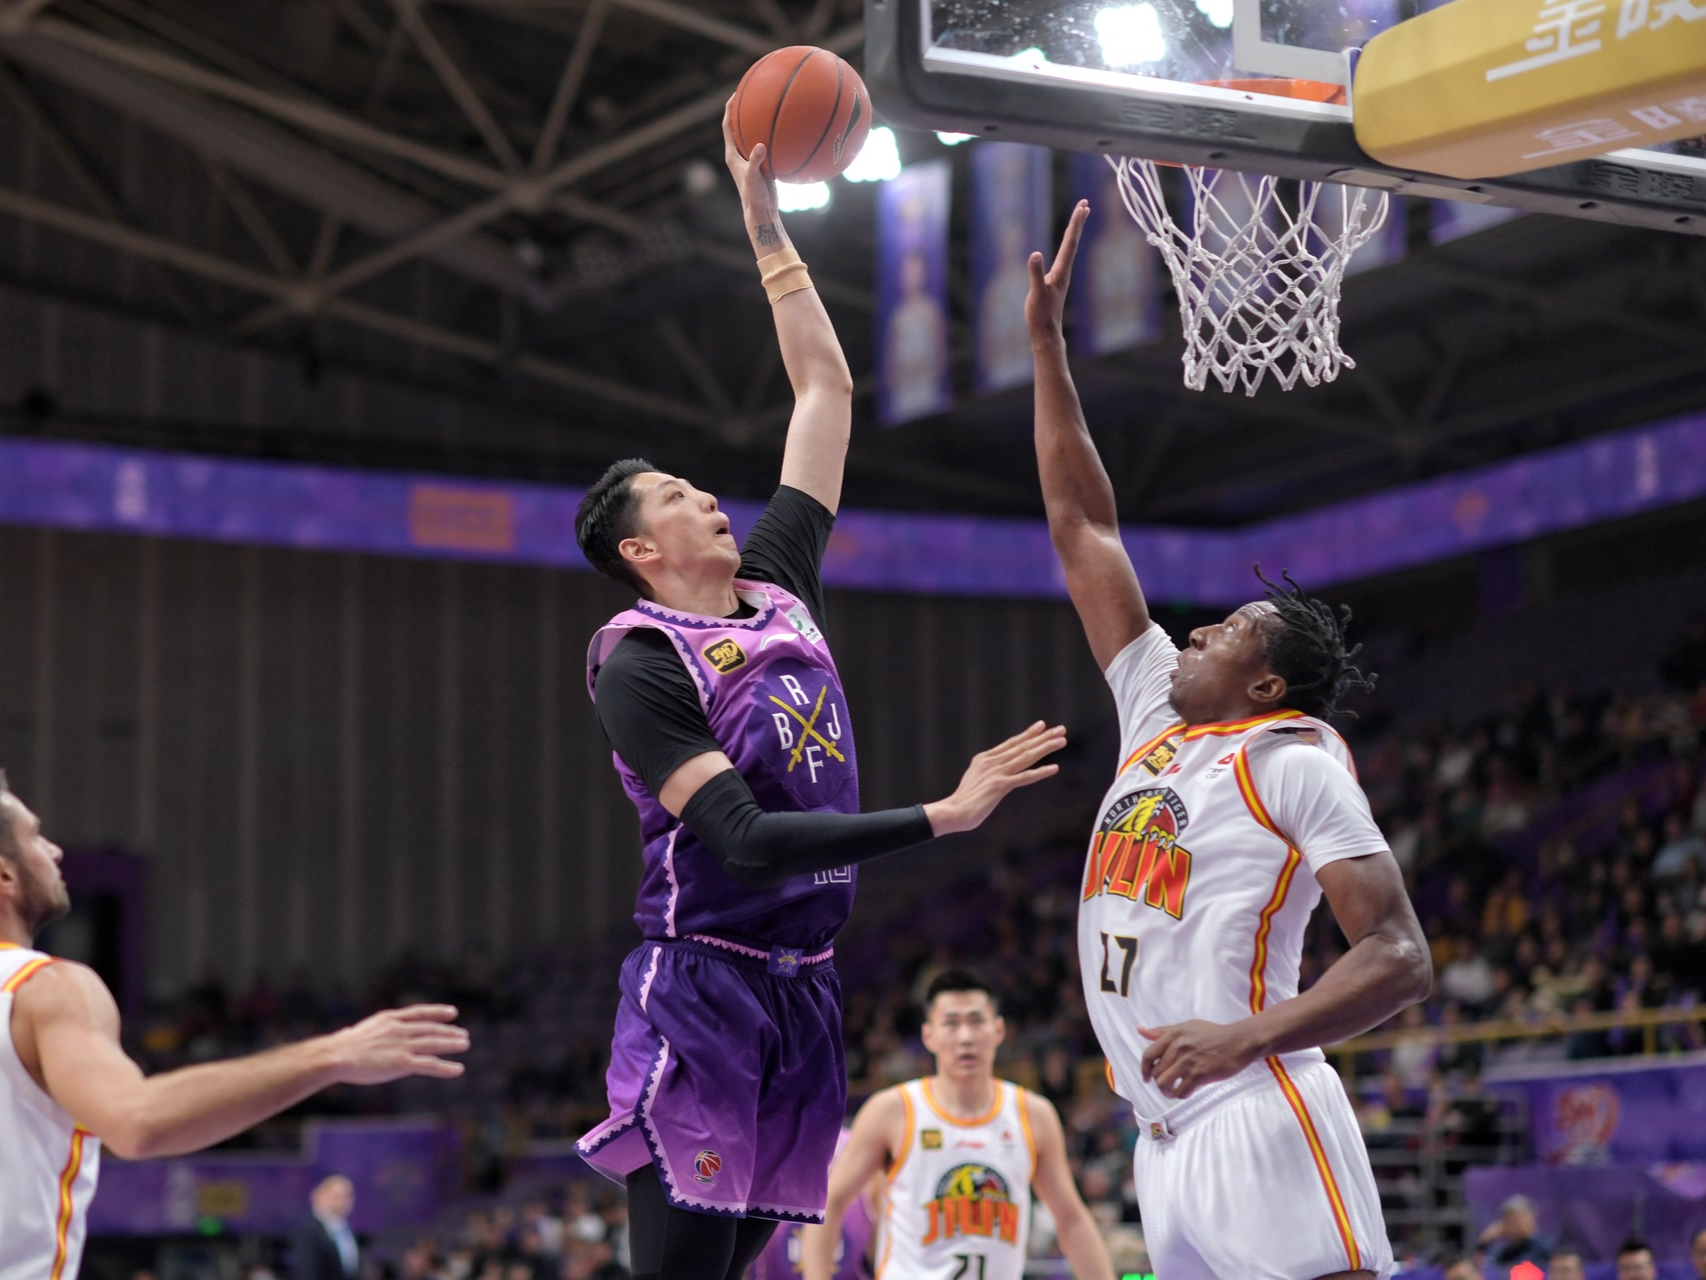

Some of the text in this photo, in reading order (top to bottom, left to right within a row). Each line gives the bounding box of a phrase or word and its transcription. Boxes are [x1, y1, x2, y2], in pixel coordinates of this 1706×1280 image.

[779, 674, 811, 706] R
[771, 703, 842, 750] B J
[805, 745, 824, 784] F
[1083, 831, 1192, 921] JILIN
[922, 1194, 1018, 1247] JILIN
